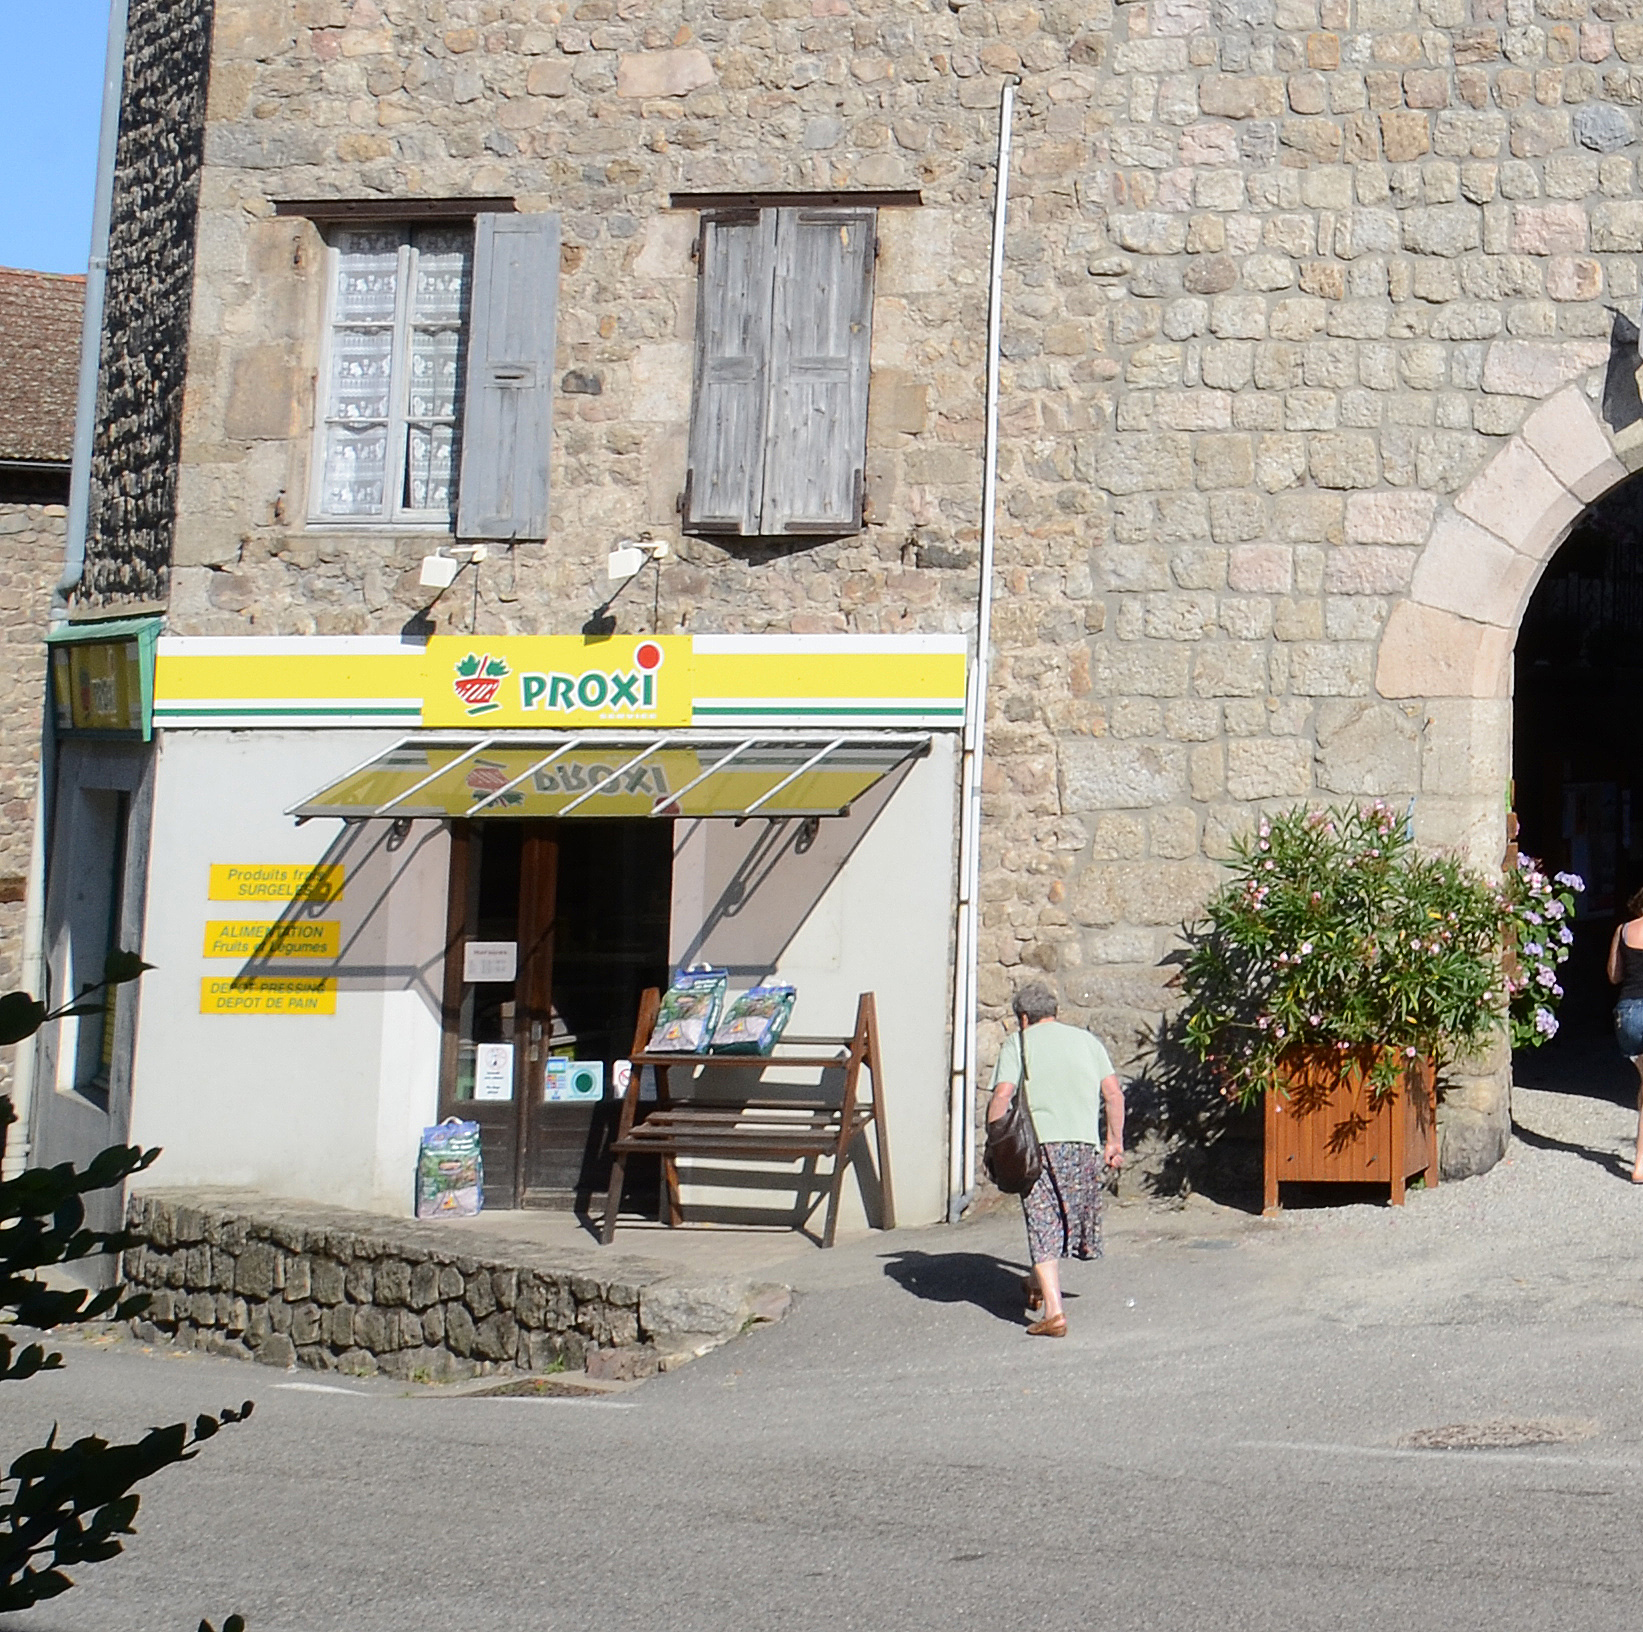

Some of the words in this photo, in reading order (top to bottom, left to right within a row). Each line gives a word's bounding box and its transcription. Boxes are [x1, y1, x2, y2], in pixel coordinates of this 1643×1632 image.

[227, 868, 287, 880] Produits
[219, 925, 324, 938] ALIMENTATION
[212, 941, 249, 952] Fruits
[266, 997, 284, 1009] DE
[288, 997, 319, 1009] PAIN
